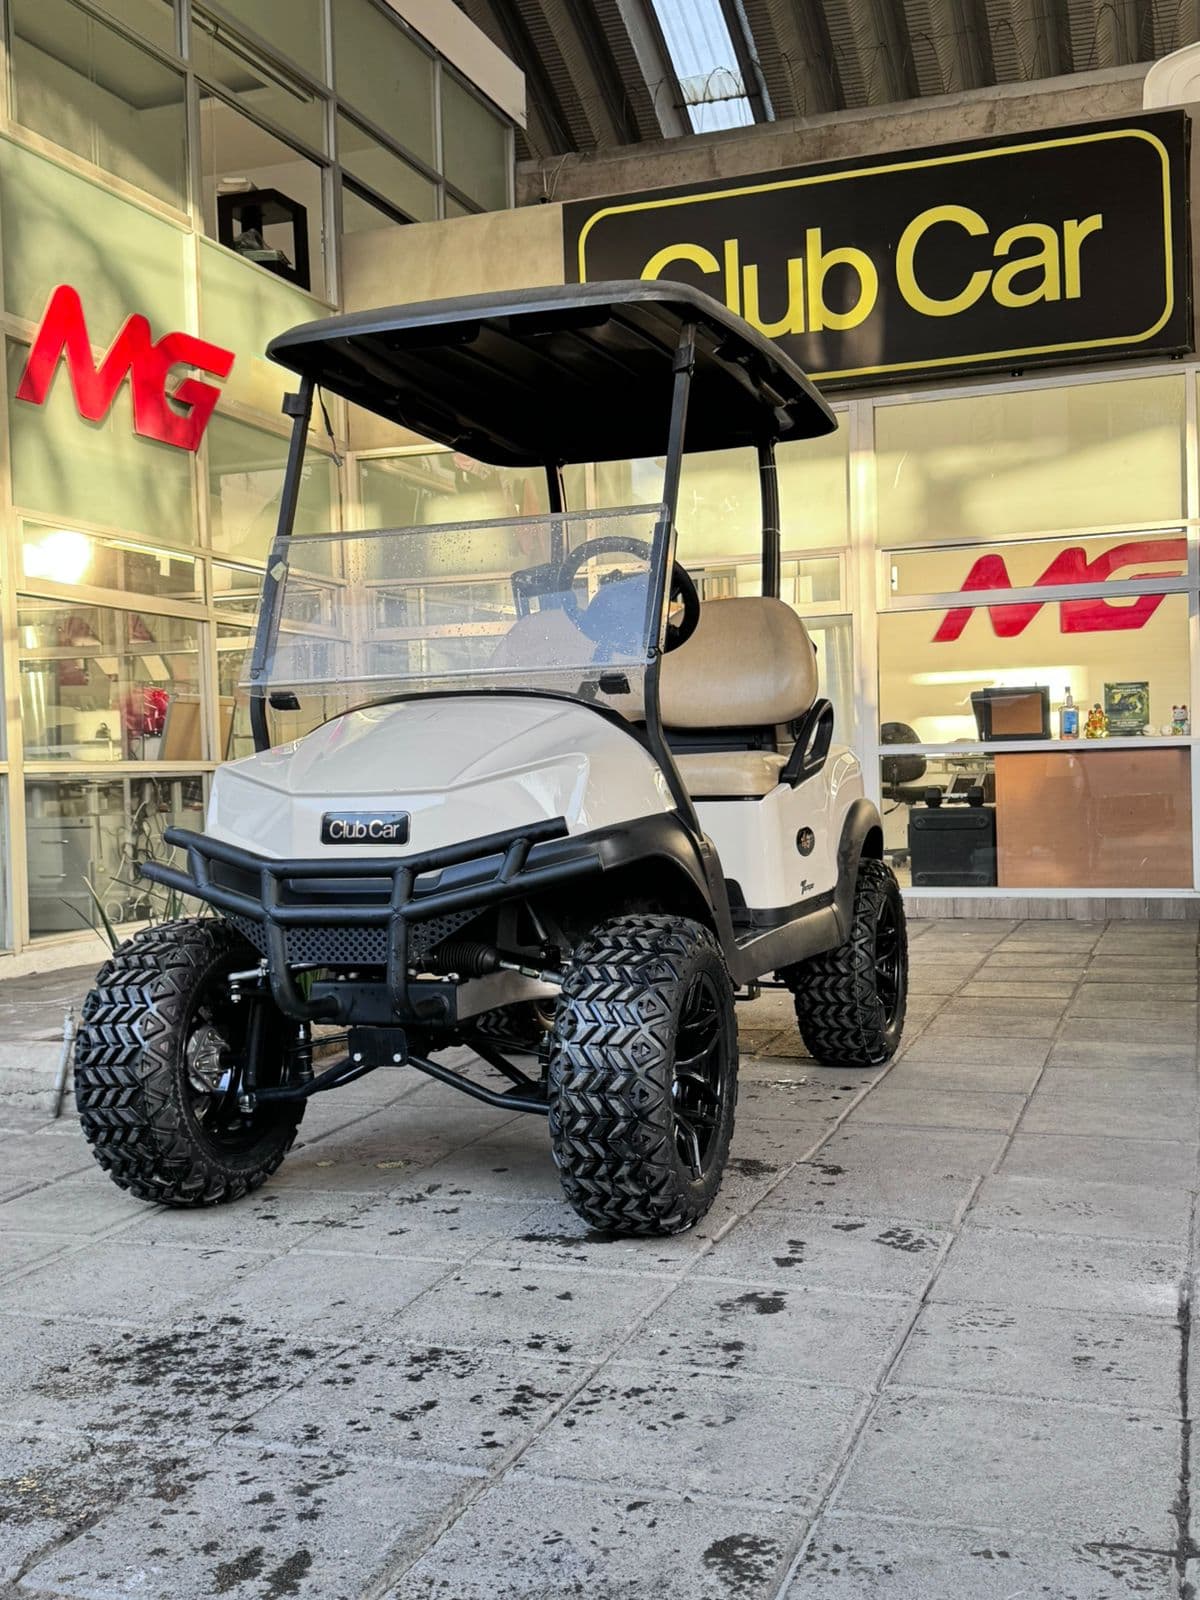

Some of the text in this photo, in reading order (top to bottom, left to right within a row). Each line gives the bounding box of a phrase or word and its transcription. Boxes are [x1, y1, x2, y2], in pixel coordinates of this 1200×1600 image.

[896, 205, 1103, 317] Car
[16, 284, 236, 453] MG
[931, 538, 1188, 643] MG
[329, 819, 401, 839] Club Car
